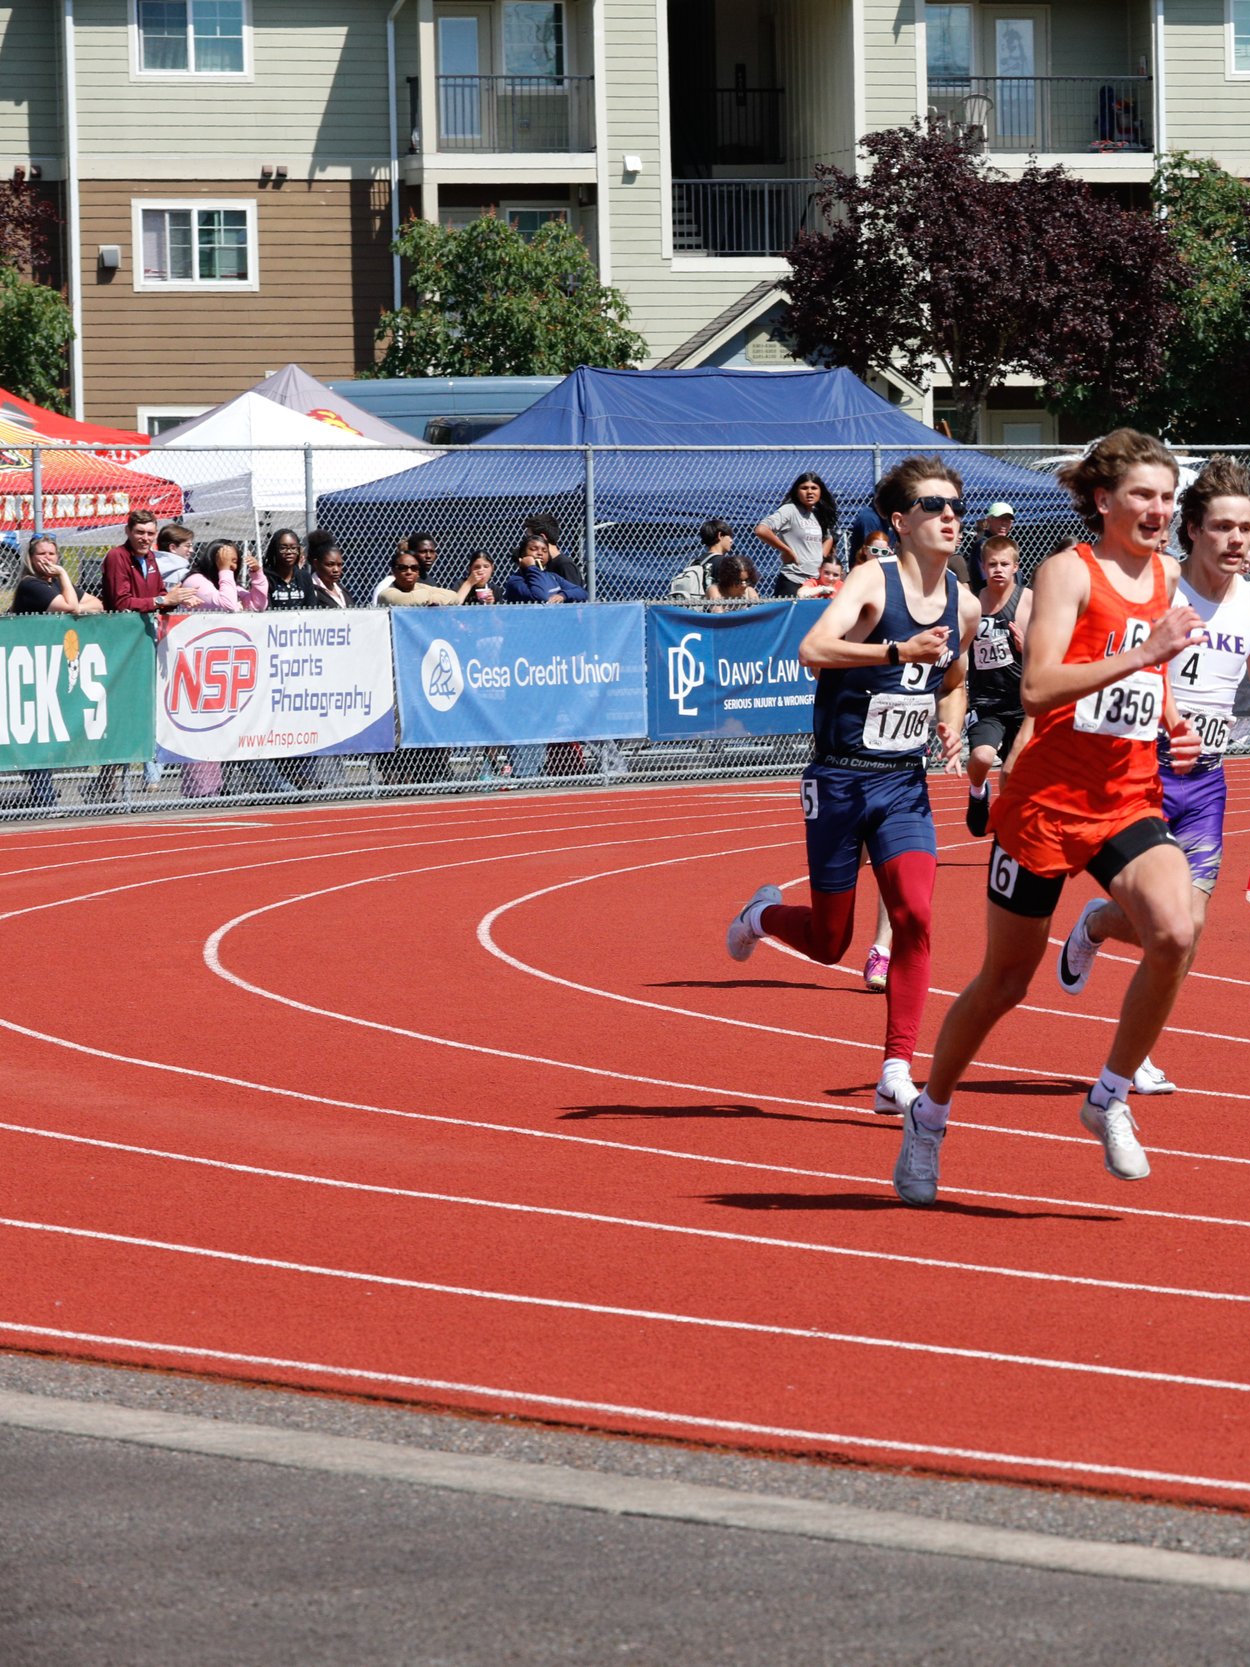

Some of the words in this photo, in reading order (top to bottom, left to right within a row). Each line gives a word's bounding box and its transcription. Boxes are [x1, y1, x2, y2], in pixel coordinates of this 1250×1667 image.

[267, 622, 351, 648] Northwest
[980, 619, 990, 638] 2
[269, 654, 323, 684] Sports
[980, 643, 1007, 664] 245
[1180, 652, 1200, 686] 4
[169, 644, 258, 714] NSP
[466, 658, 511, 689] Gesa
[514, 655, 568, 687] Credit
[572, 654, 620, 685] Union
[718, 658, 764, 687] DAVIS
[767, 656, 800, 684] LAW
[271, 684, 372, 717] Photography
[723, 698, 752, 710] SERIOUS
[753, 697, 778, 709] INJURY
[777, 696, 784, 707] &
[1093, 687, 1155, 726] 1359
[238, 729, 319, 748] www.4nsp.com
[878, 709, 929, 740] 1708
[1182, 713, 1229, 749] 305
[803, 781, 814, 817] 5
[995, 853, 1013, 893] 6
